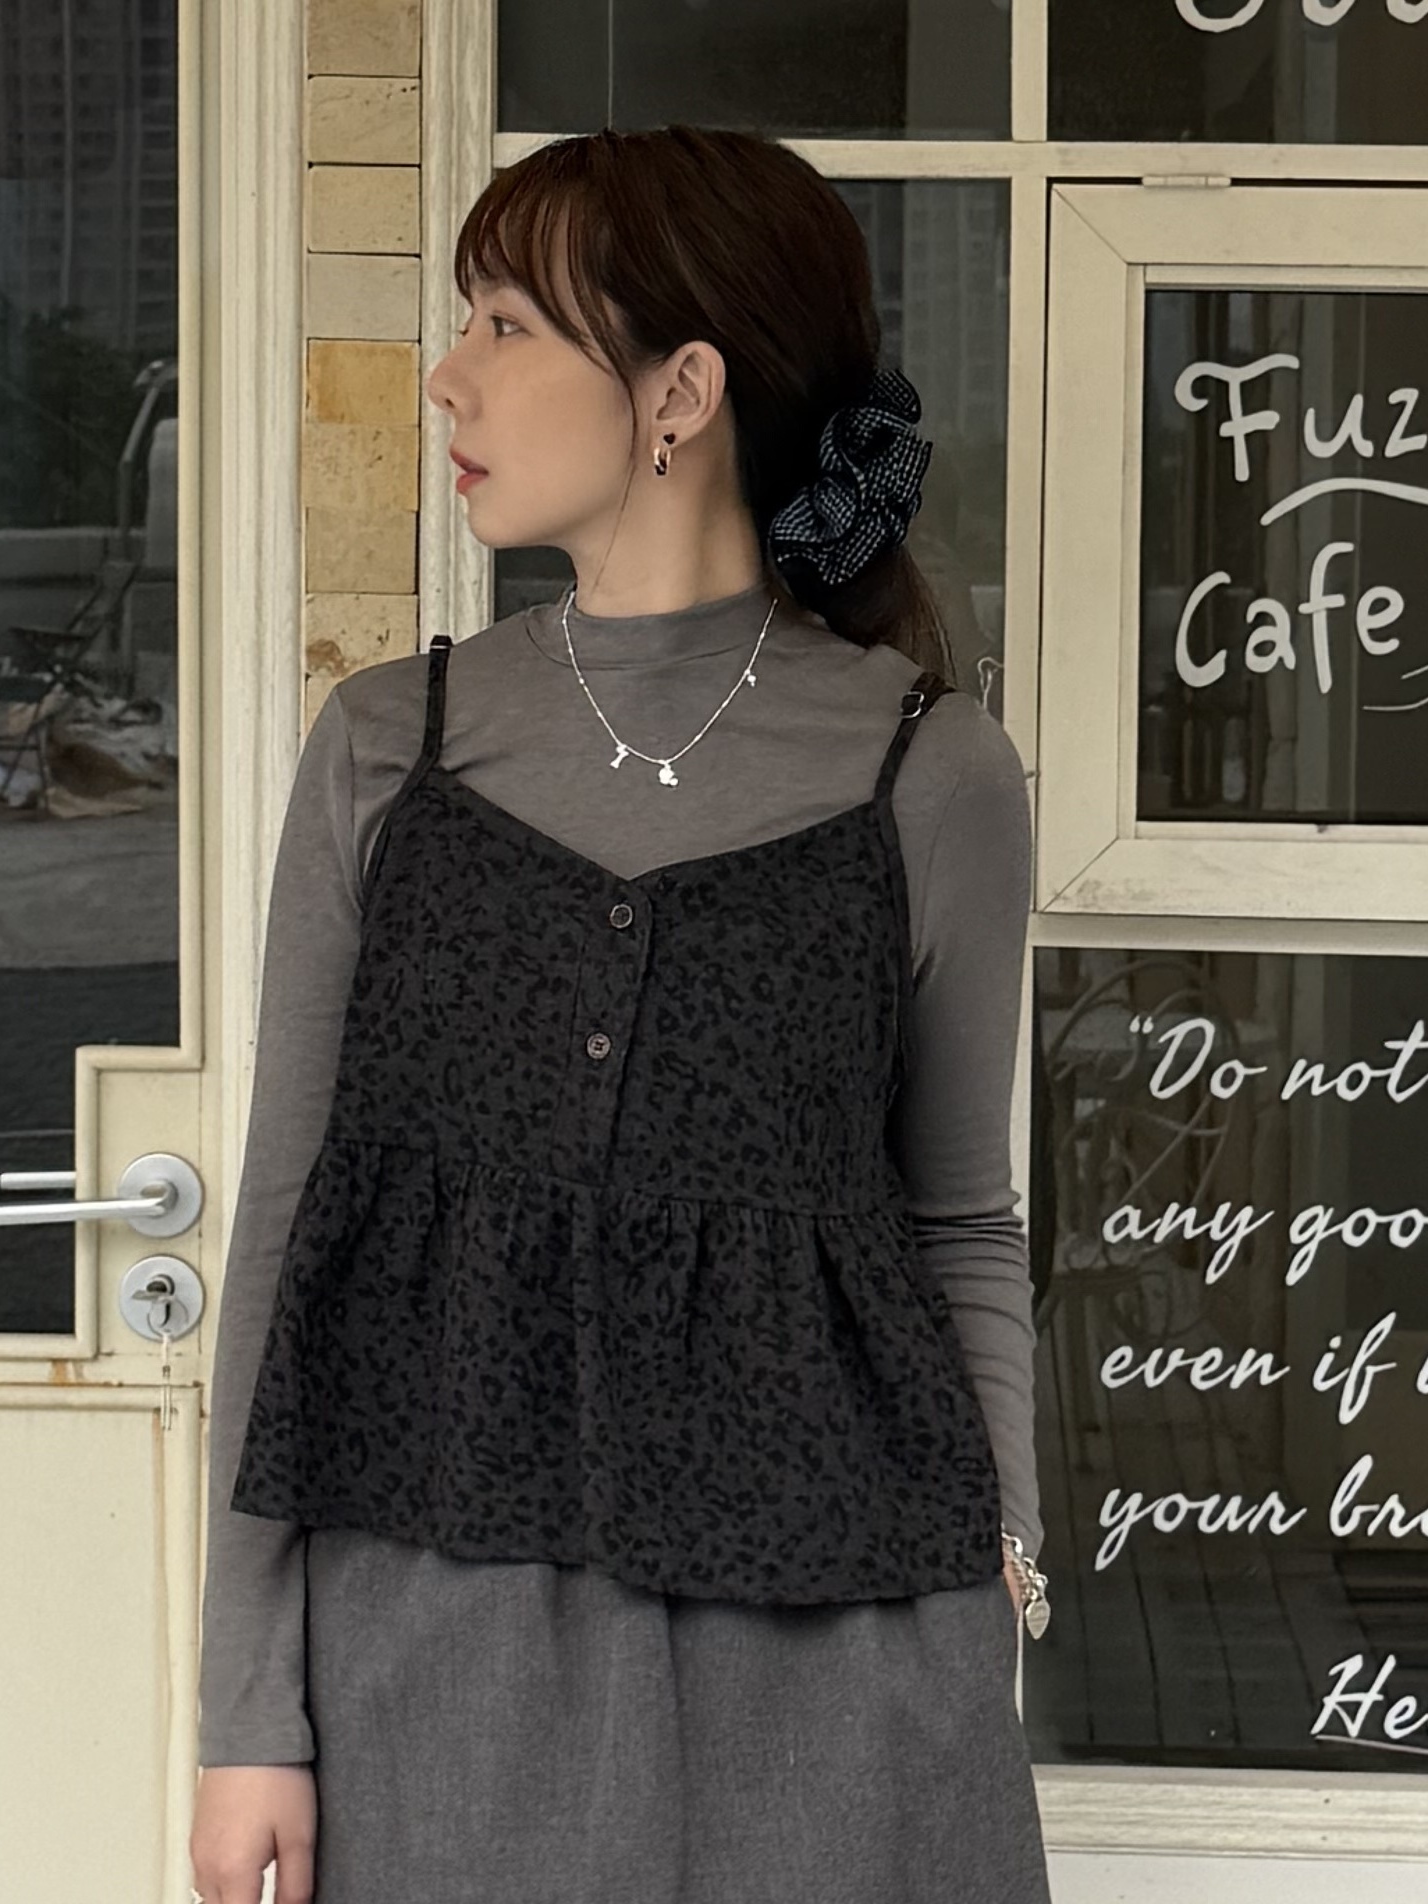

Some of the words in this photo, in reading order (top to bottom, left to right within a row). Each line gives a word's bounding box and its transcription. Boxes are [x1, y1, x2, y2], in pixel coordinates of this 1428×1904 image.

[1174, 540, 1405, 694] Cafe
[1101, 1200, 1276, 1286] any
[1099, 1344, 1291, 1391] even
[1311, 1311, 1399, 1425] if
[1093, 1487, 1309, 1572] your
